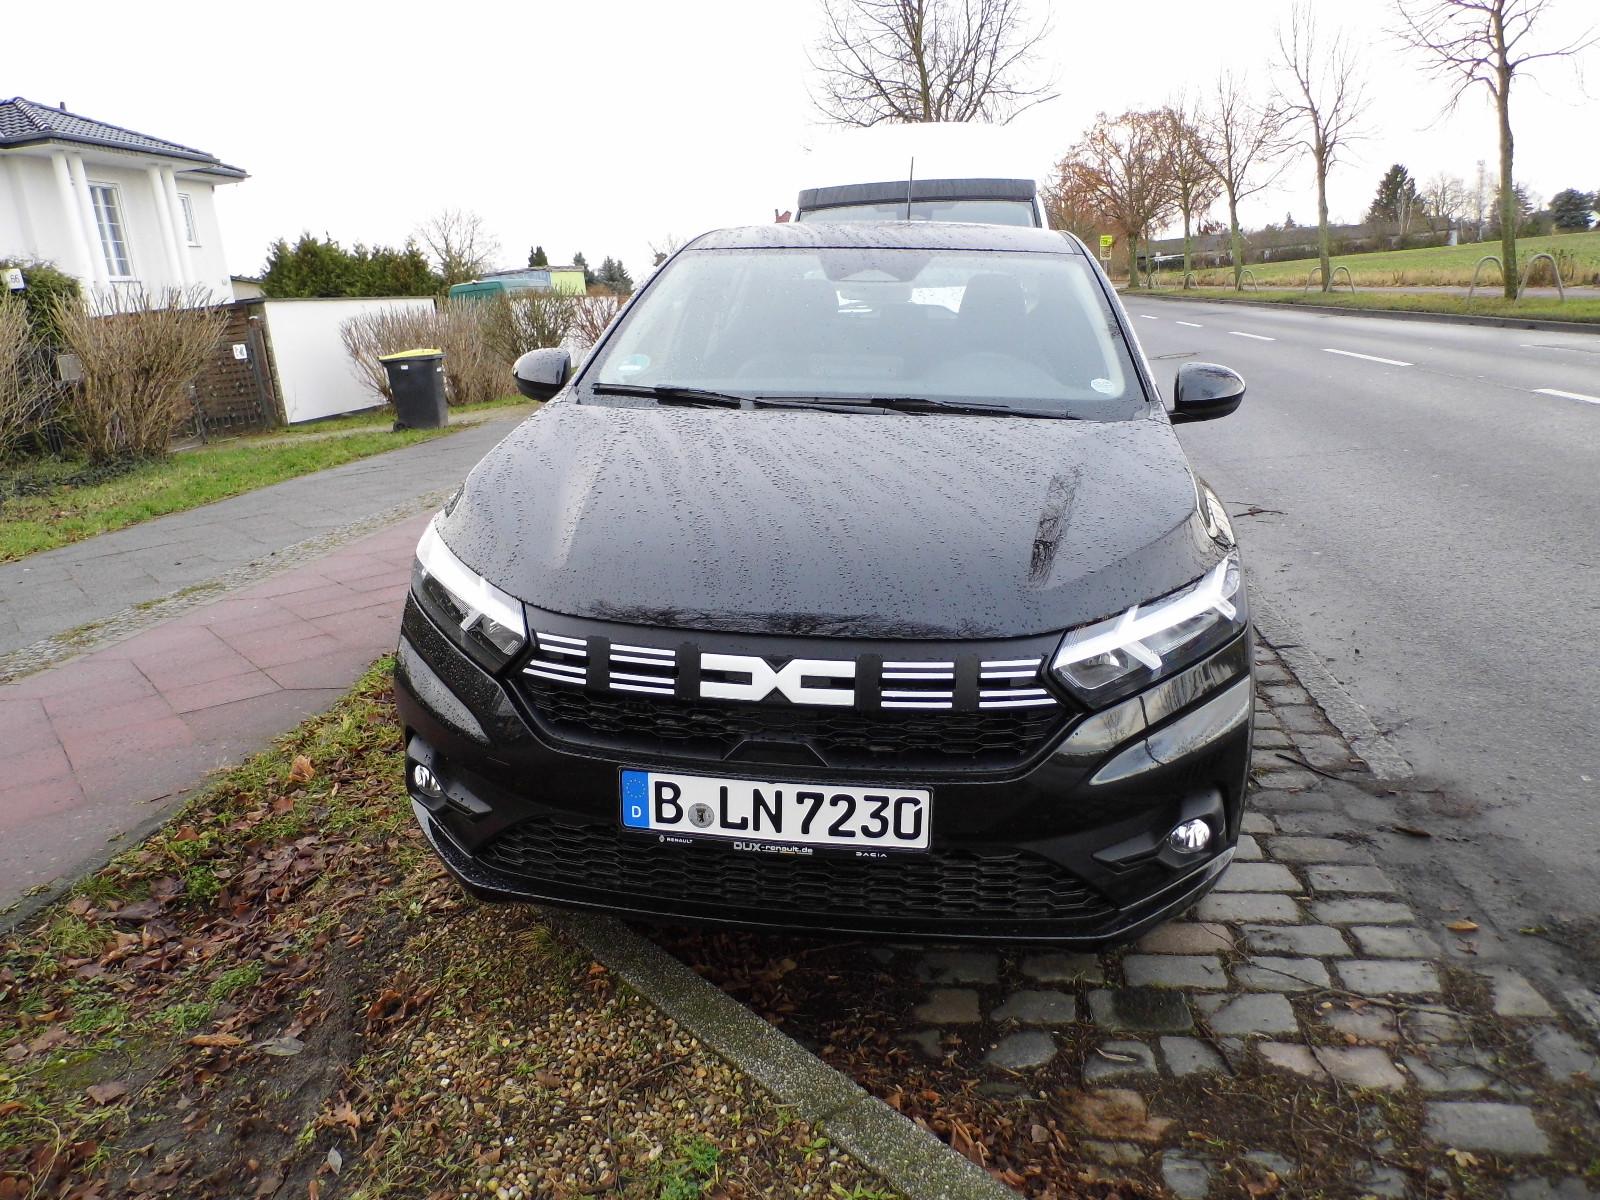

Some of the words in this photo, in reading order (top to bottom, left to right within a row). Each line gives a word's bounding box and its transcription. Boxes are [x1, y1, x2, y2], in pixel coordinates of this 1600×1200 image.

[631, 805, 642, 818] D
[655, 781, 684, 824] B
[719, 785, 783, 833] LN
[796, 791, 922, 840] 7230
